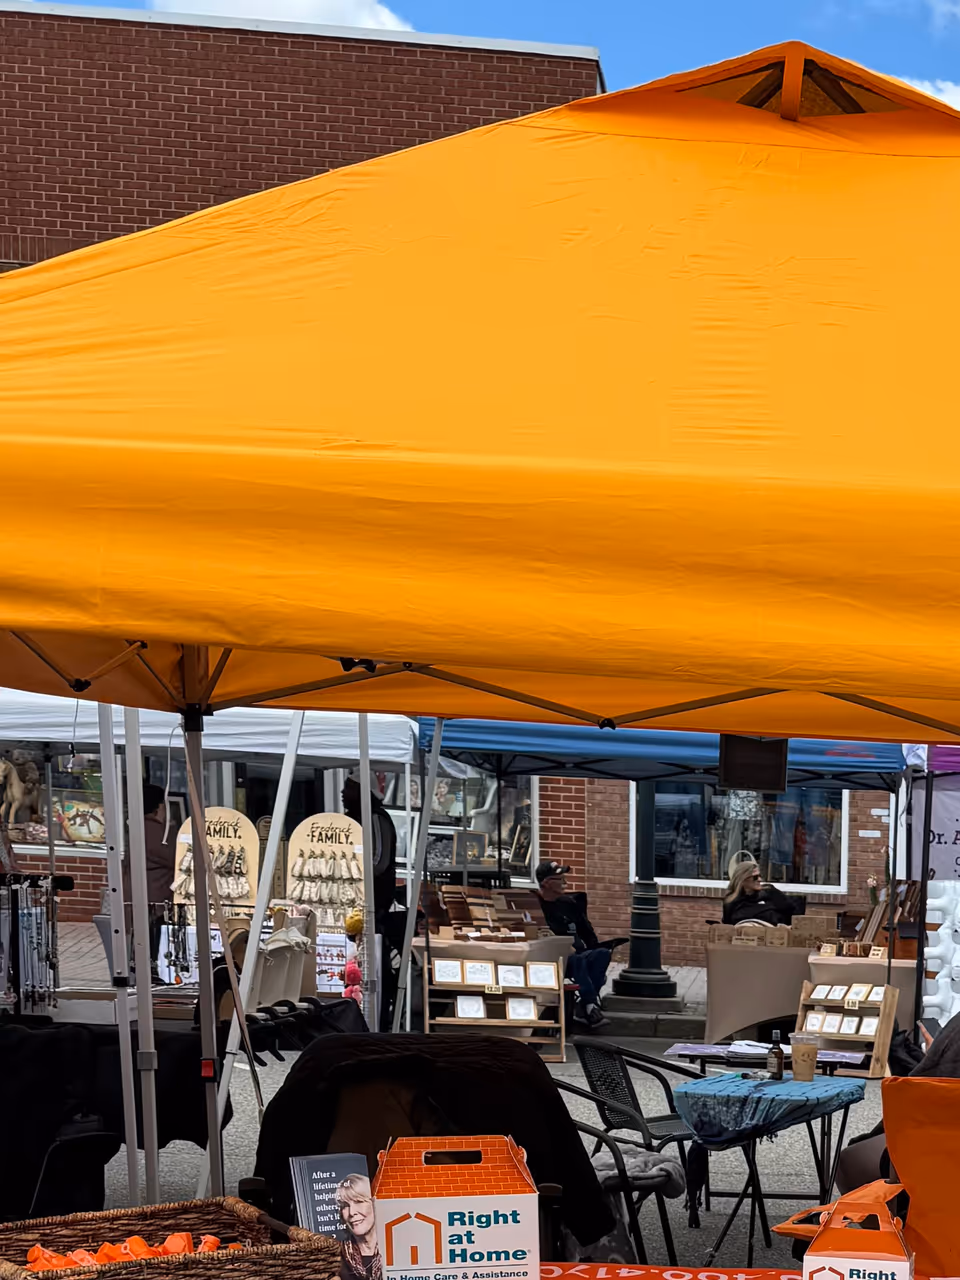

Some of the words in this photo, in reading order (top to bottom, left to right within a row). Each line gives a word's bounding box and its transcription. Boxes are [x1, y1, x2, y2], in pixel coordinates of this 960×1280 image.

[204, 816, 241, 829] rederick
[311, 822, 353, 836] Frederick
[205, 825, 242, 840] AMILY.
[312, 1171, 330, 1179] After
[313, 1181, 341, 1191] lifetime
[343, 1180, 351, 1188] of
[448, 1210, 521, 1228] Right
[318, 1225, 336, 1233] time
[337, 1223, 347, 1231] for
[448, 1231, 475, 1245] at
[449, 1248, 527, 1263] Home
[434, 1273, 458, 1280] Care
[472, 1270, 528, 1279] Assistance
